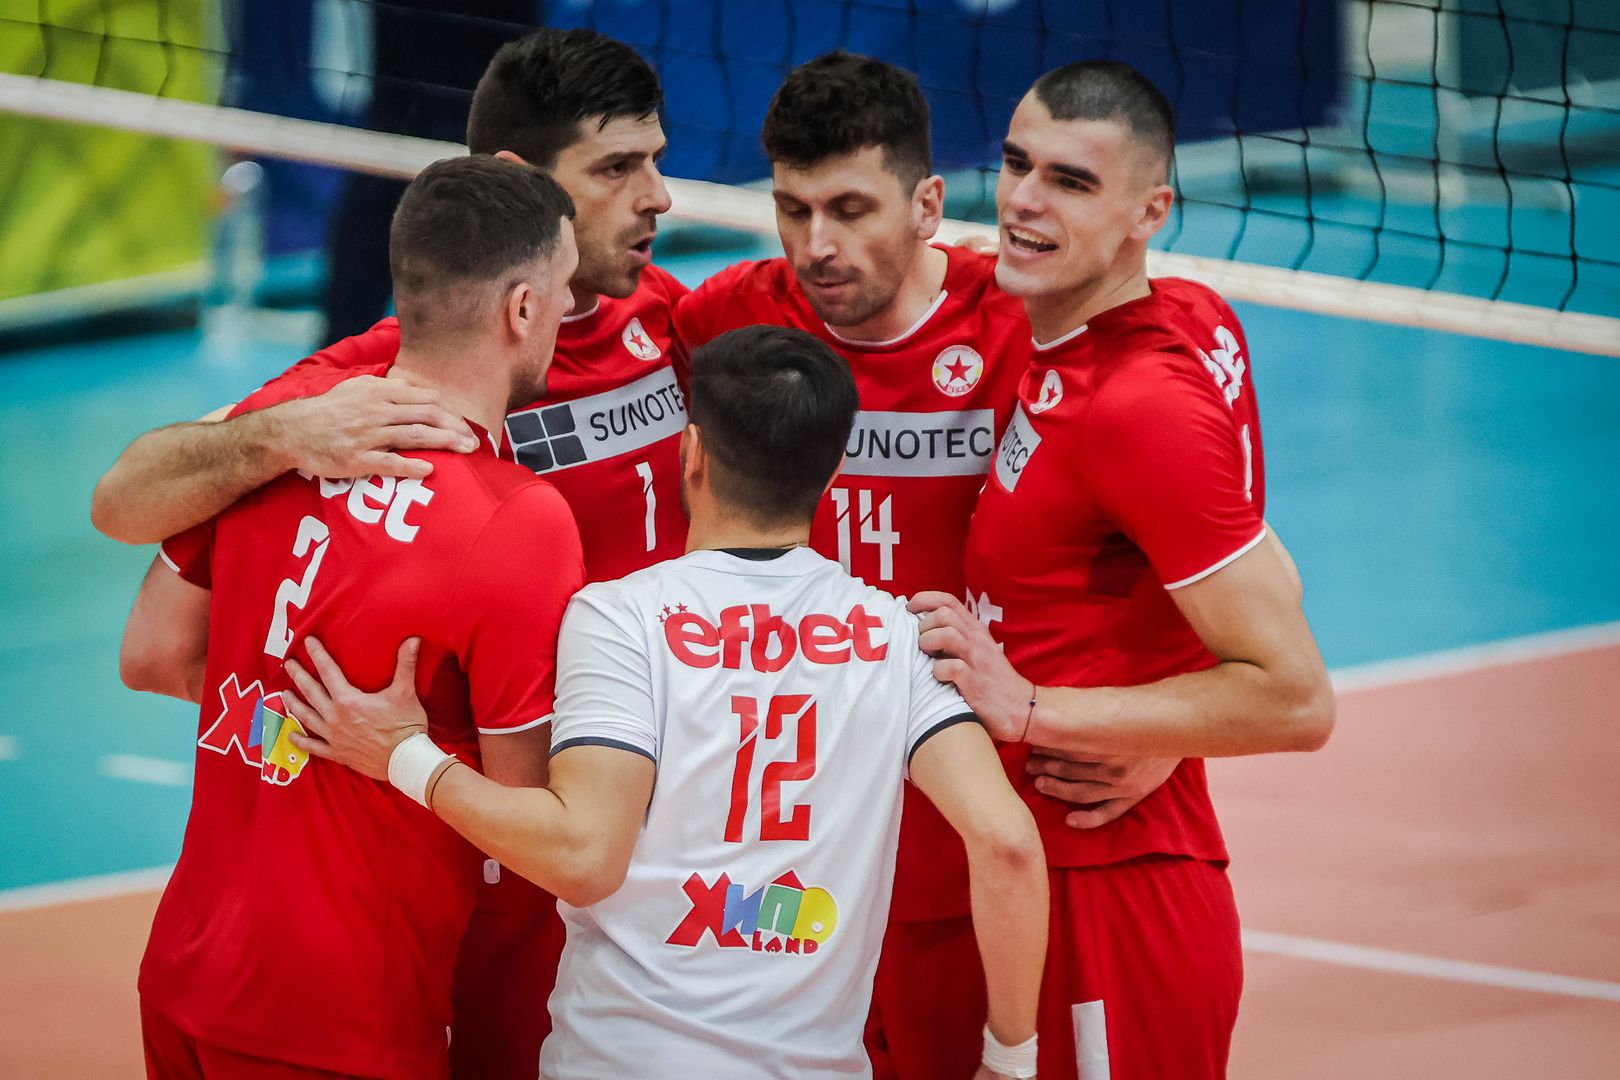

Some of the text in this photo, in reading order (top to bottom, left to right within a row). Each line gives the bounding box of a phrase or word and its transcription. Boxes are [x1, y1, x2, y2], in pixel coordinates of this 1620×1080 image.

[590, 383, 684, 441] SUNOTE
[846, 427, 992, 460] UNOTEC
[635, 461, 656, 552] 1
[831, 488, 900, 580] 14
[264, 515, 330, 660] 2
[664, 604, 888, 673] efbet
[724, 694, 817, 843] 12
[752, 930, 819, 955] LAND
